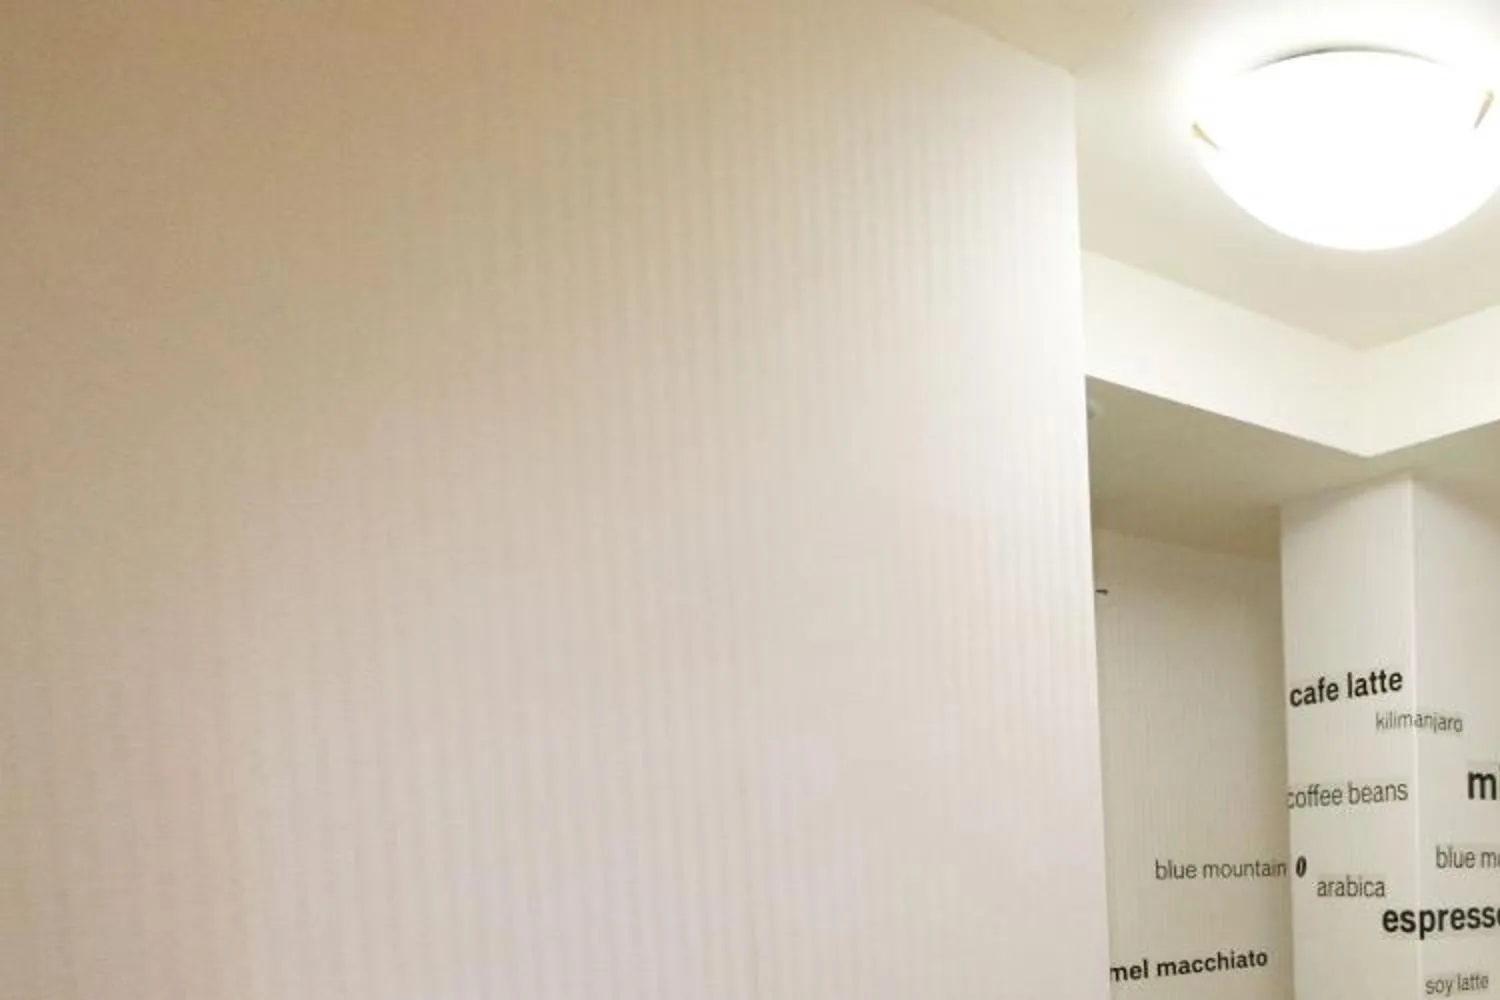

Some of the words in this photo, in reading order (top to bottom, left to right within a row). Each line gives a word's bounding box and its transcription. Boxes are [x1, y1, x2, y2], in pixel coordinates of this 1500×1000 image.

[1289, 676, 1339, 707] cafe
[1346, 669, 1403, 699] latte
[1375, 711, 1463, 733] kilimanjaro
[1347, 780, 1409, 805] beans
[1155, 858, 1197, 880] blue
[1202, 860, 1287, 879] mountain
[1435, 845, 1476, 869] blue
[1316, 873, 1386, 897] arabica
[1110, 959, 1149, 982] mel
[1157, 949, 1268, 977] macchiato
[1425, 979, 1453, 997] soy
[1457, 972, 1489, 991] latte
